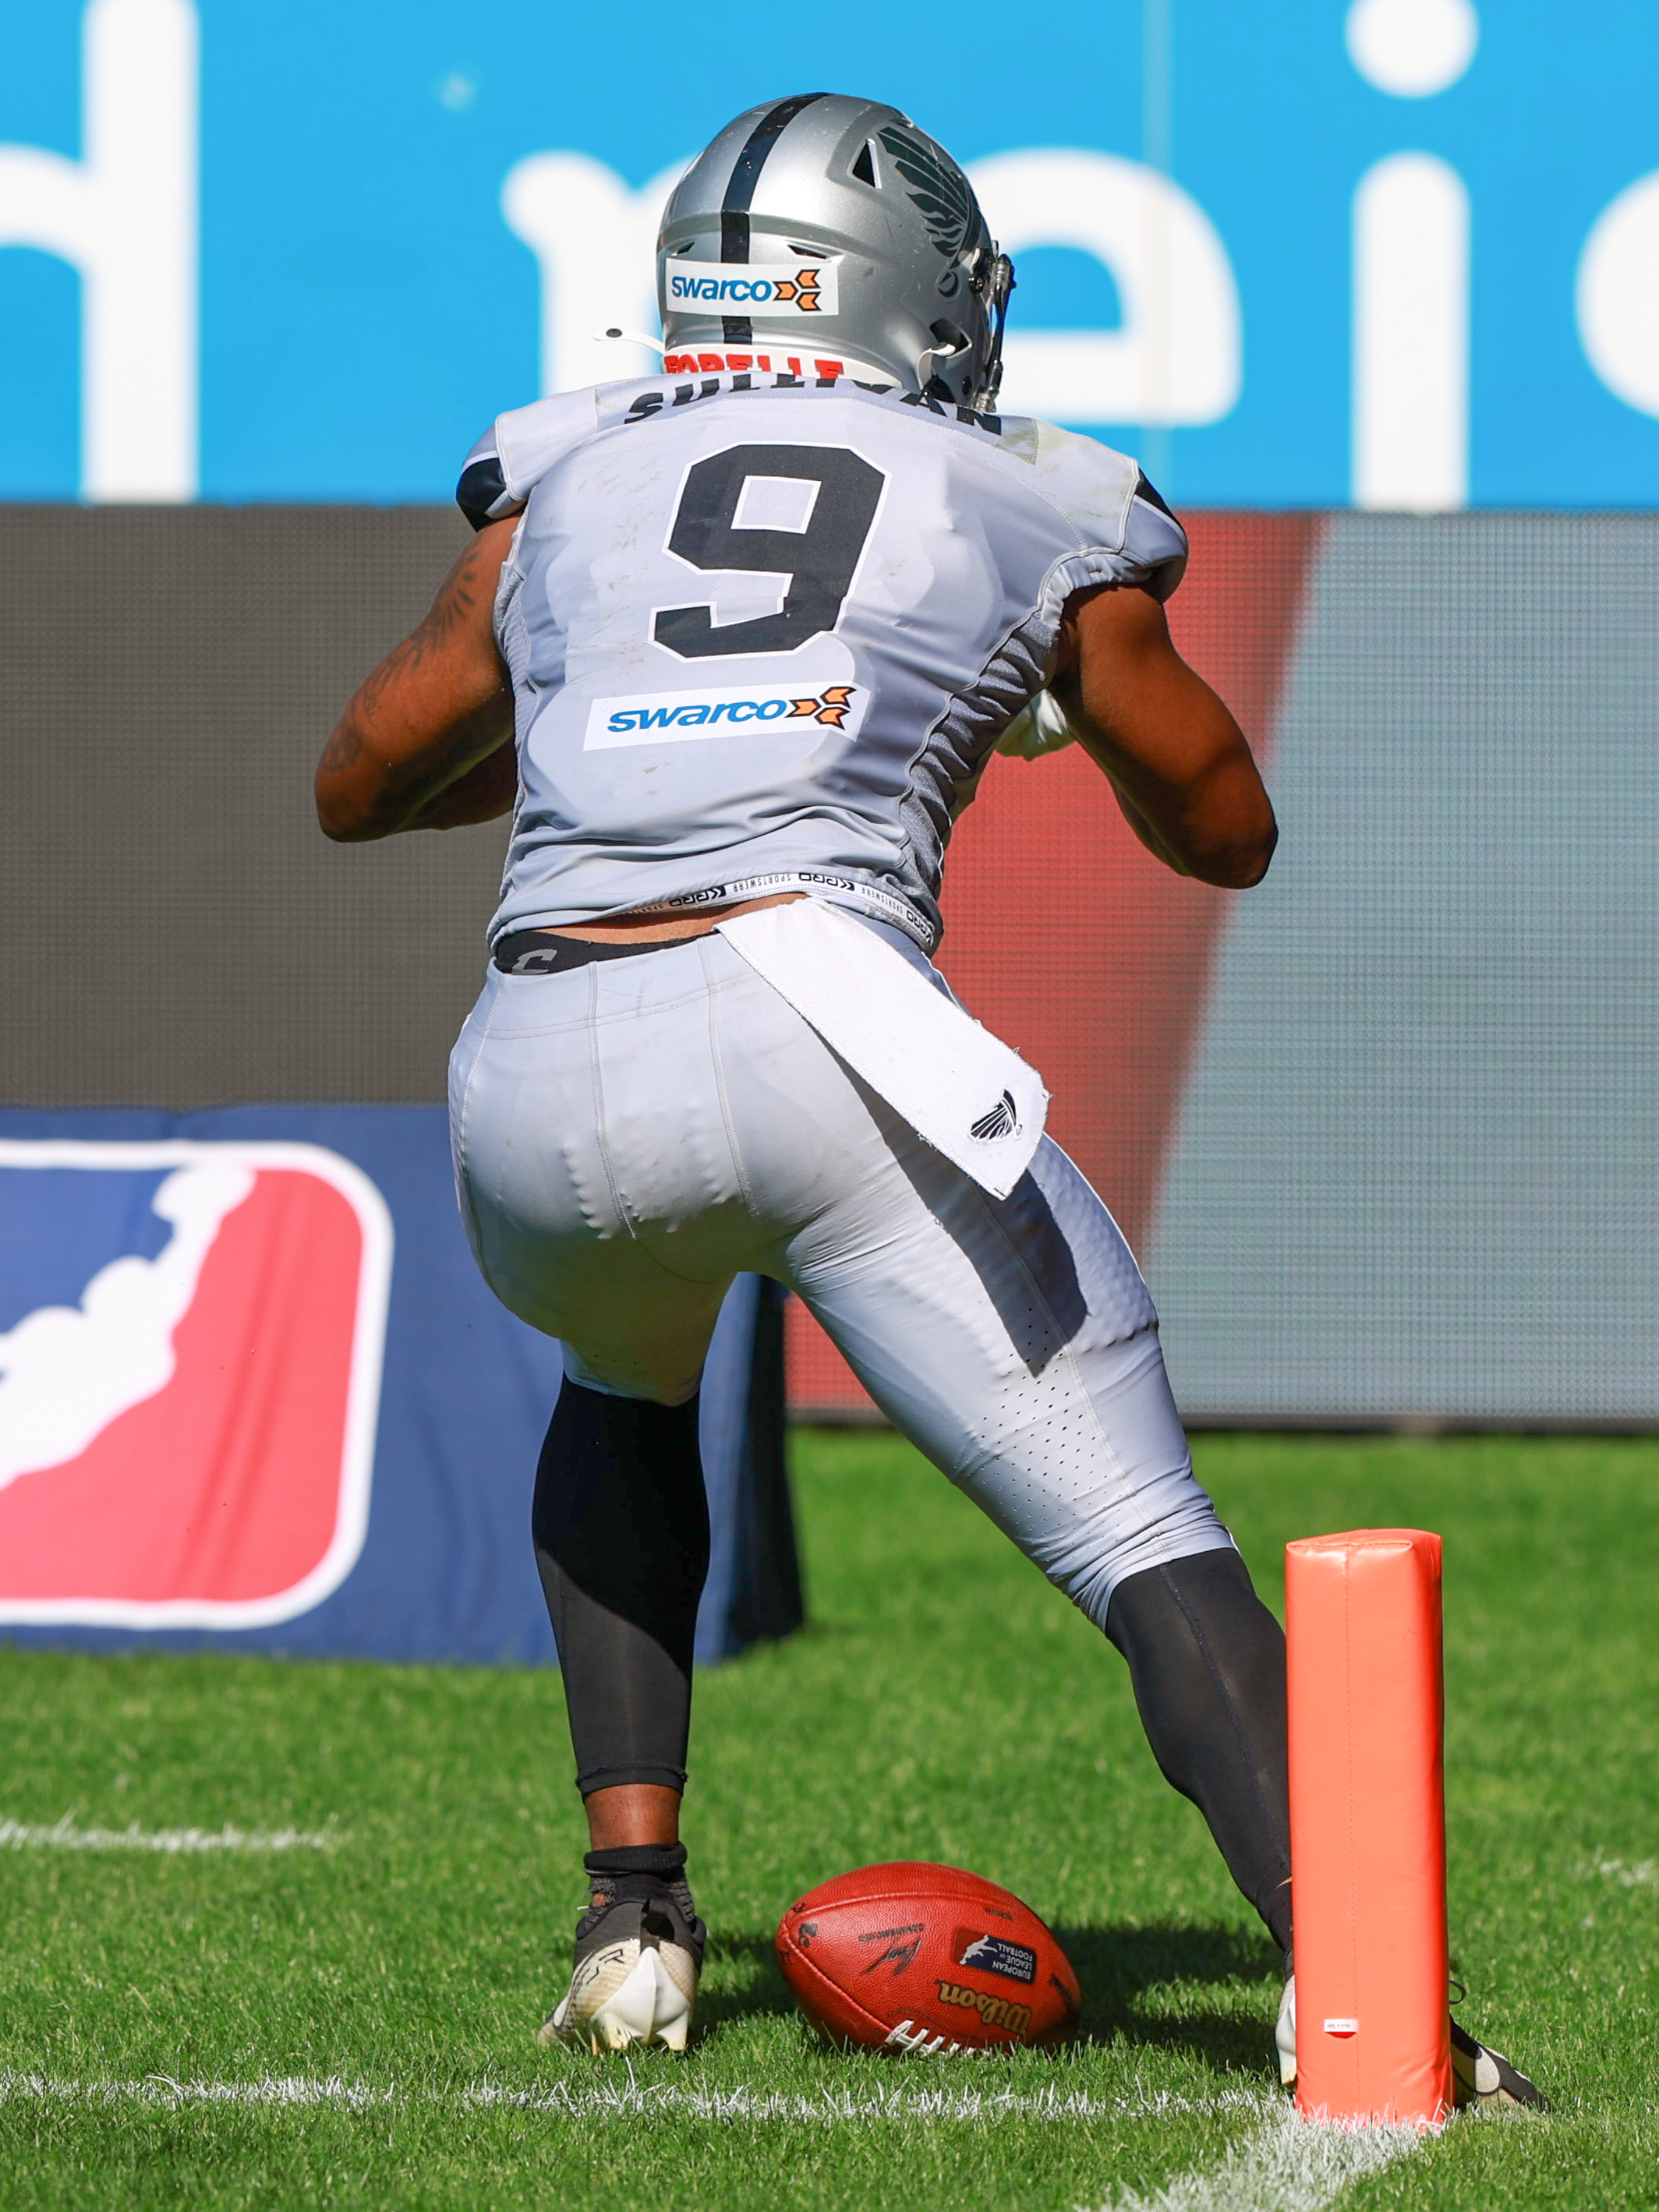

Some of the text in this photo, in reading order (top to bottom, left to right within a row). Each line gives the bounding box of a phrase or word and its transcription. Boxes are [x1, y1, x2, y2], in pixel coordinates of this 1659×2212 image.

[670, 274, 773, 302] swarco
[649, 442, 891, 662] 9
[607, 698, 787, 733] swarco
[733, 872, 792, 892] SPORTSWEAR
[996, 1943, 1033, 1961] FOOTBALL
[1006, 1954, 1032, 1970] LEAGUE
[992, 1960, 1031, 1980] EUROPEAN
[937, 1981, 1032, 2034] Wilson
